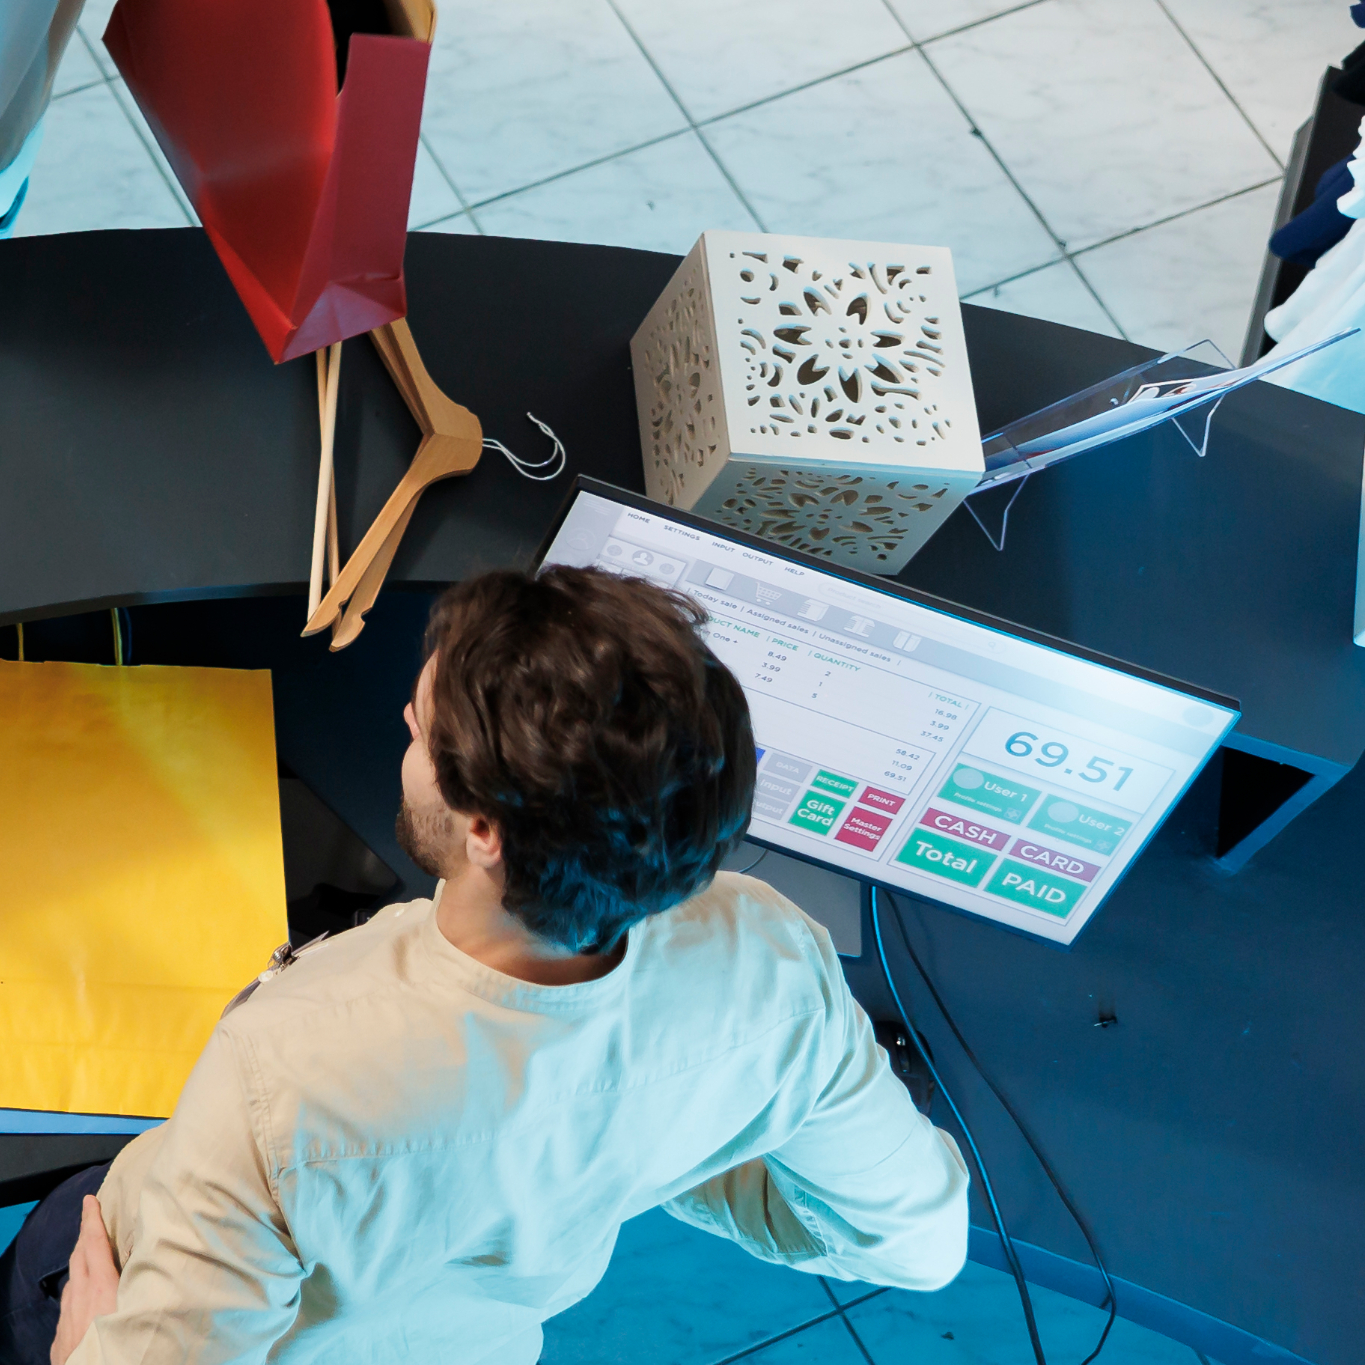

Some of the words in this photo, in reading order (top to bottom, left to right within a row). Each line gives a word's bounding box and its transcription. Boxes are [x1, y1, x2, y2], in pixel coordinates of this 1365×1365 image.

[628, 512, 650, 524] HOME
[663, 525, 701, 541] SETTINGS
[712, 542, 735, 553] INPUT
[742, 552, 775, 566] OUTPUT
[784, 566, 805, 577] HELP
[693, 590, 717, 605] Today
[720, 598, 738, 610] sale
[747, 609, 786, 627] Assigned
[787, 623, 809, 635] sales
[819, 633, 868, 654] Unassigned
[870, 651, 891, 662] sales
[733, 624, 760, 638] NAME
[713, 632, 731, 643] One
[771, 638, 798, 651] PRICE
[767, 651, 787, 662] 8.49
[813, 653, 861, 672] QUANTITY
[761, 662, 781, 673] 3.99
[754, 673, 773, 683] 7.49
[934, 694, 962, 708] TOTAL
[935, 709, 958, 721] 16.98
[929, 721, 950, 730] 3.99
[920, 731, 944, 742] 37.45
[895, 748, 920, 761] 58.42
[1005, 731, 1134, 792] 69.51
[775, 762, 799, 774] DATA
[891, 760, 913, 771] 11.09
[816, 775, 854, 792] RECEIPT
[884, 771, 907, 782] 69.51
[760, 779, 792, 795] Input
[984, 781, 1017, 800] User
[1021, 793, 1028, 802] 1
[806, 799, 836, 816] Gift
[867, 793, 896, 807] PRINT
[954, 792, 975, 803] Profile
[976, 801, 1002, 813] settings
[756, 801, 784, 815] utput
[796, 809, 834, 827] Card
[851, 817, 882, 832] Master
[1079, 814, 1112, 832] User
[1114, 826, 1125, 836] 2
[844, 824, 881, 841] Settings
[933, 815, 997, 845] CASH
[916, 841, 978, 873] Total
[1020, 845, 1084, 875] CARD
[1001, 873, 1066, 903] PAID
